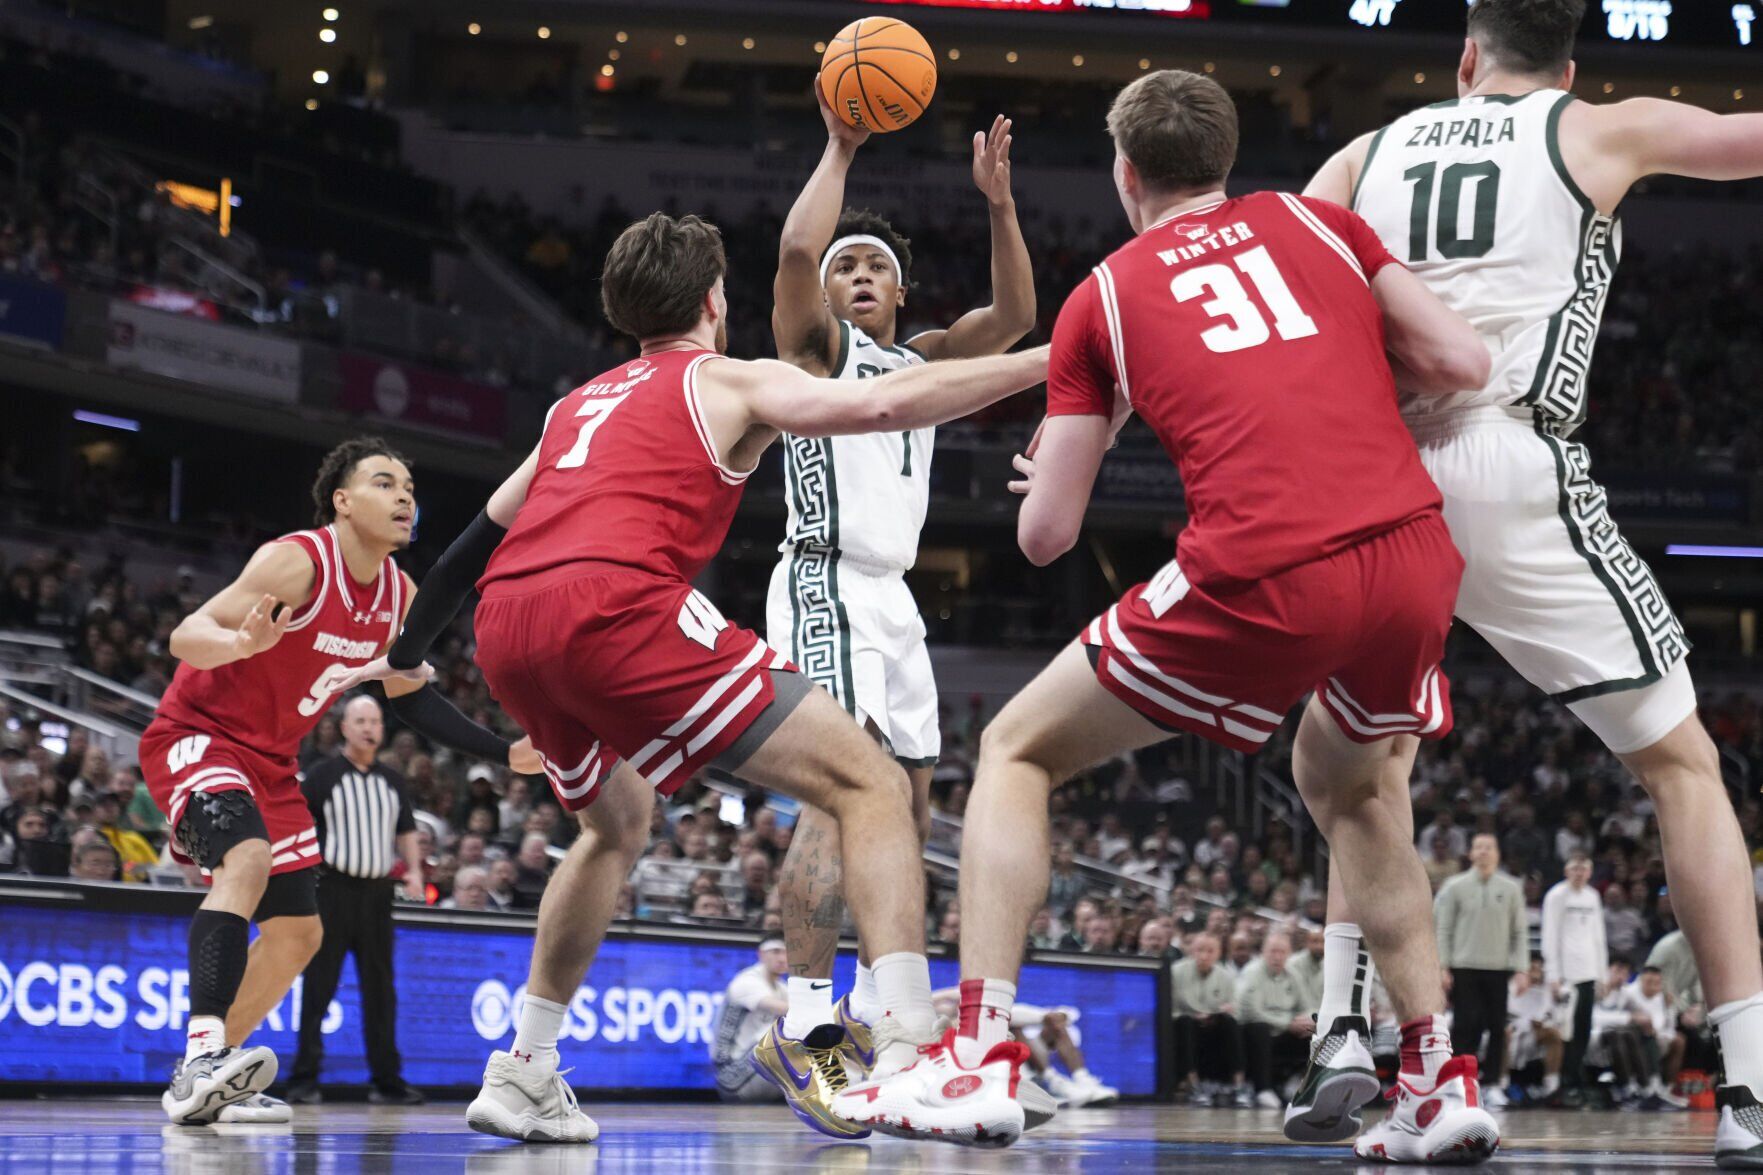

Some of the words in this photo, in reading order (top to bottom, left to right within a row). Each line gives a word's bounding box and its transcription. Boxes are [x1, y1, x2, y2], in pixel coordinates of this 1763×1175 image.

[1405, 117, 1516, 148] ZAPALA
[1403, 160, 1501, 262] 10
[1156, 221, 1255, 266] WINTER
[1170, 245, 1319, 353] 31
[555, 390, 633, 469] 7
[677, 588, 729, 652] W
[297, 662, 349, 717] 9
[166, 734, 212, 776] W
[14, 961, 128, 1029] CBS
[602, 986, 727, 1044] SPOR
